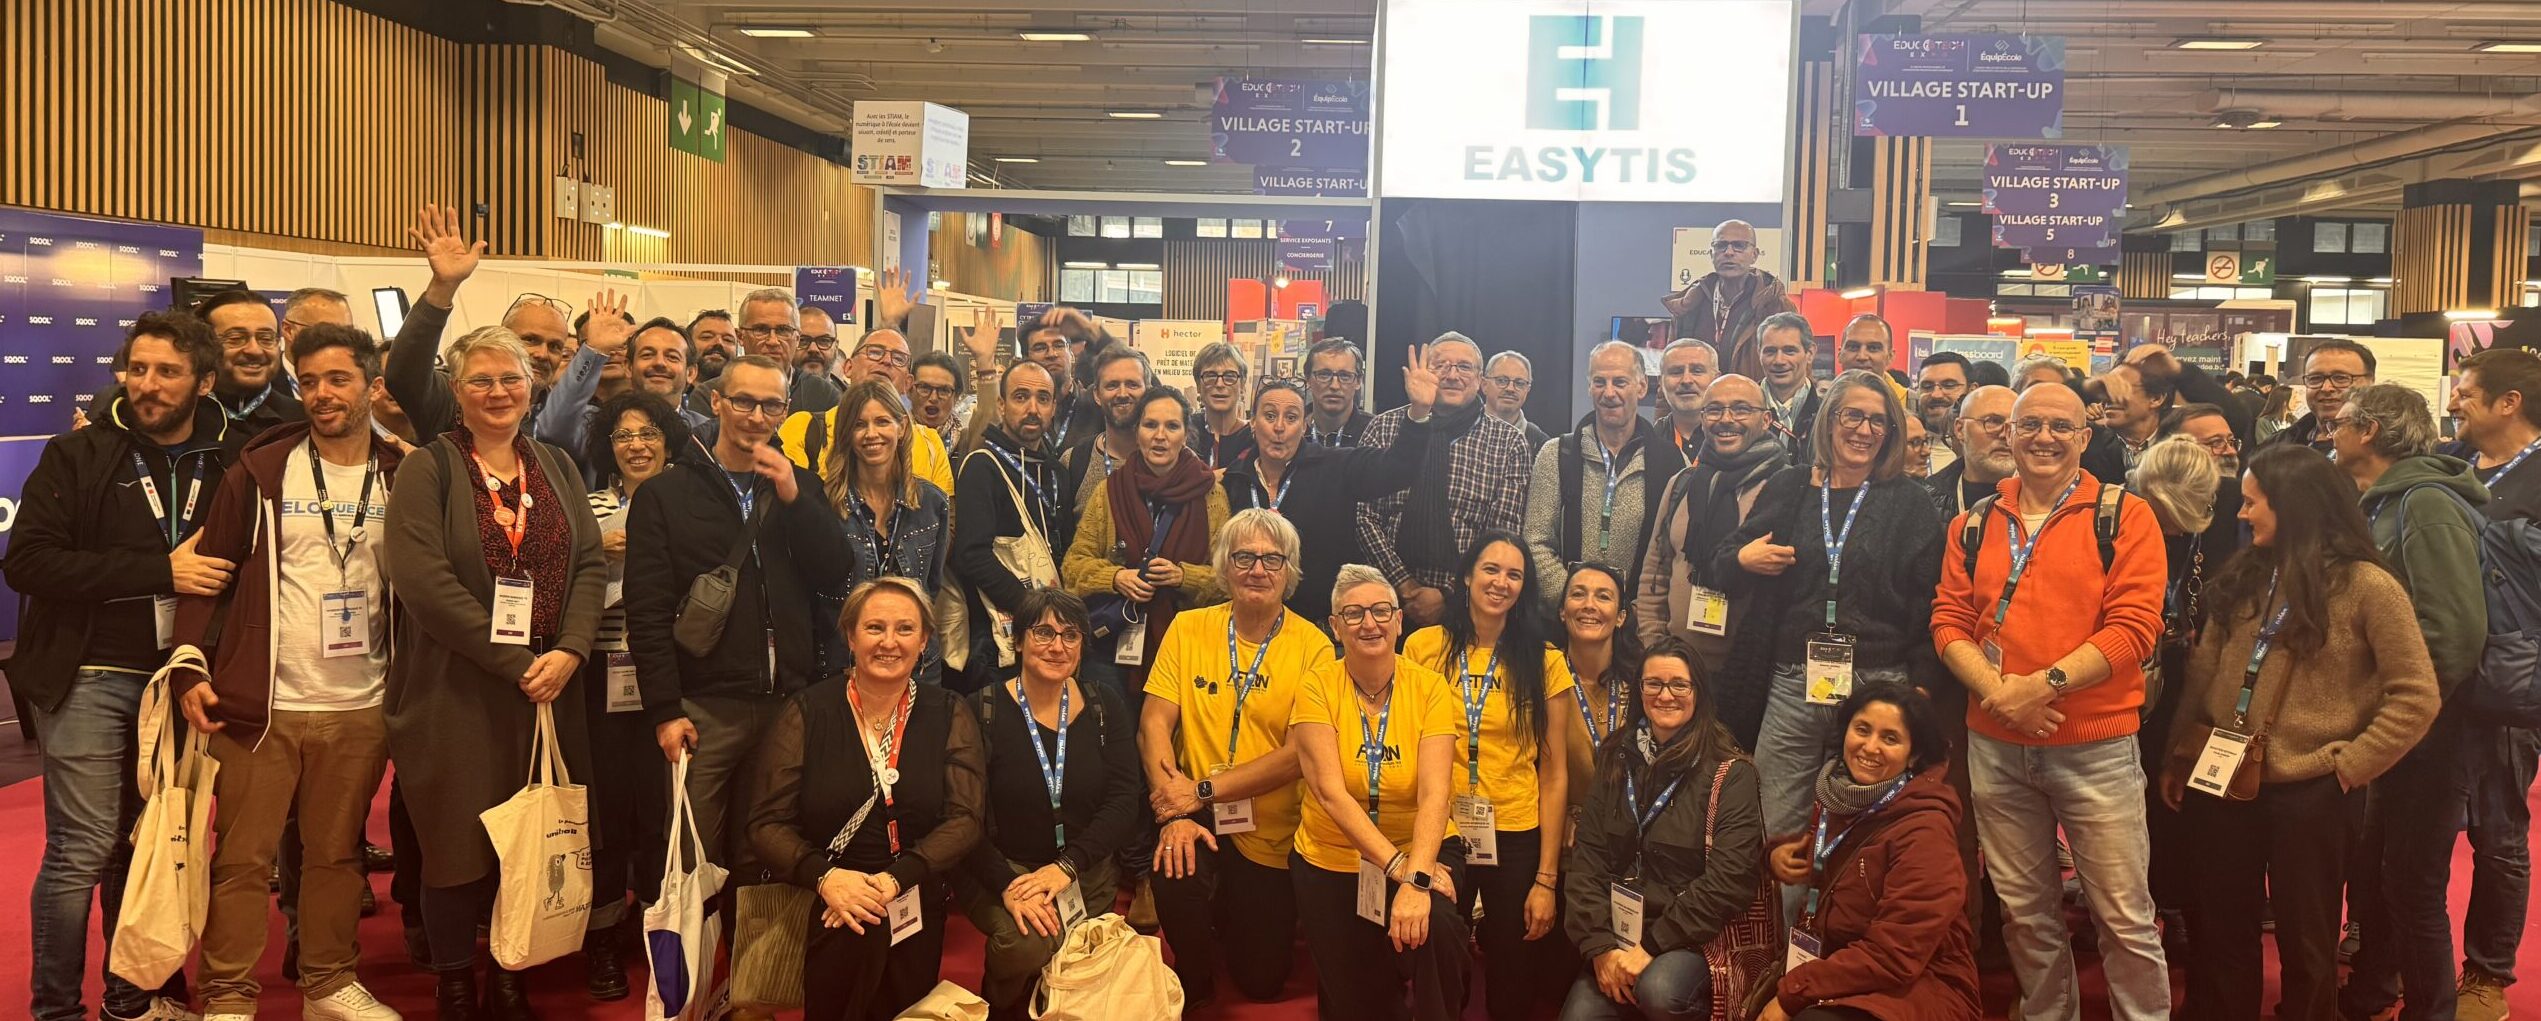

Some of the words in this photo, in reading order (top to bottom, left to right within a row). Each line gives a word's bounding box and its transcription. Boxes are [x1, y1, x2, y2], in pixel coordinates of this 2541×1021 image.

[1868, 80, 1952, 98] VILLAGE
[1957, 81, 2053, 99] START-UP
[1954, 104, 1969, 126] 1
[1221, 117, 1290, 133] VILLAGE
[1290, 138, 1301, 157] 2
[857, 154, 912, 171] STIAM
[1464, 145, 1698, 184] EASYTIS
[1260, 176, 1313, 189] VILLAGE
[1316, 178, 1367, 190] START-U
[1991, 176, 2050, 189] VILLAGE
[2053, 177, 2121, 190] START-UP
[2049, 193, 2059, 208] 3
[1325, 220, 1333, 232] 7
[1999, 215, 2047, 225] VILLAGE
[2049, 215, 2104, 226] START-UP
[2046, 228, 2055, 241] 5
[2067, 248, 2075, 259] 8
[809, 294, 843, 302] TEAMNET
[842, 313, 851, 321] E1
[1173, 329, 1202, 338] hector
[2157, 328, 2177, 352] Hey
[2181, 324, 2231, 344] teachers,
[1171, 359, 1179, 367] DE
[281, 501, 385, 516] ELOUECE
